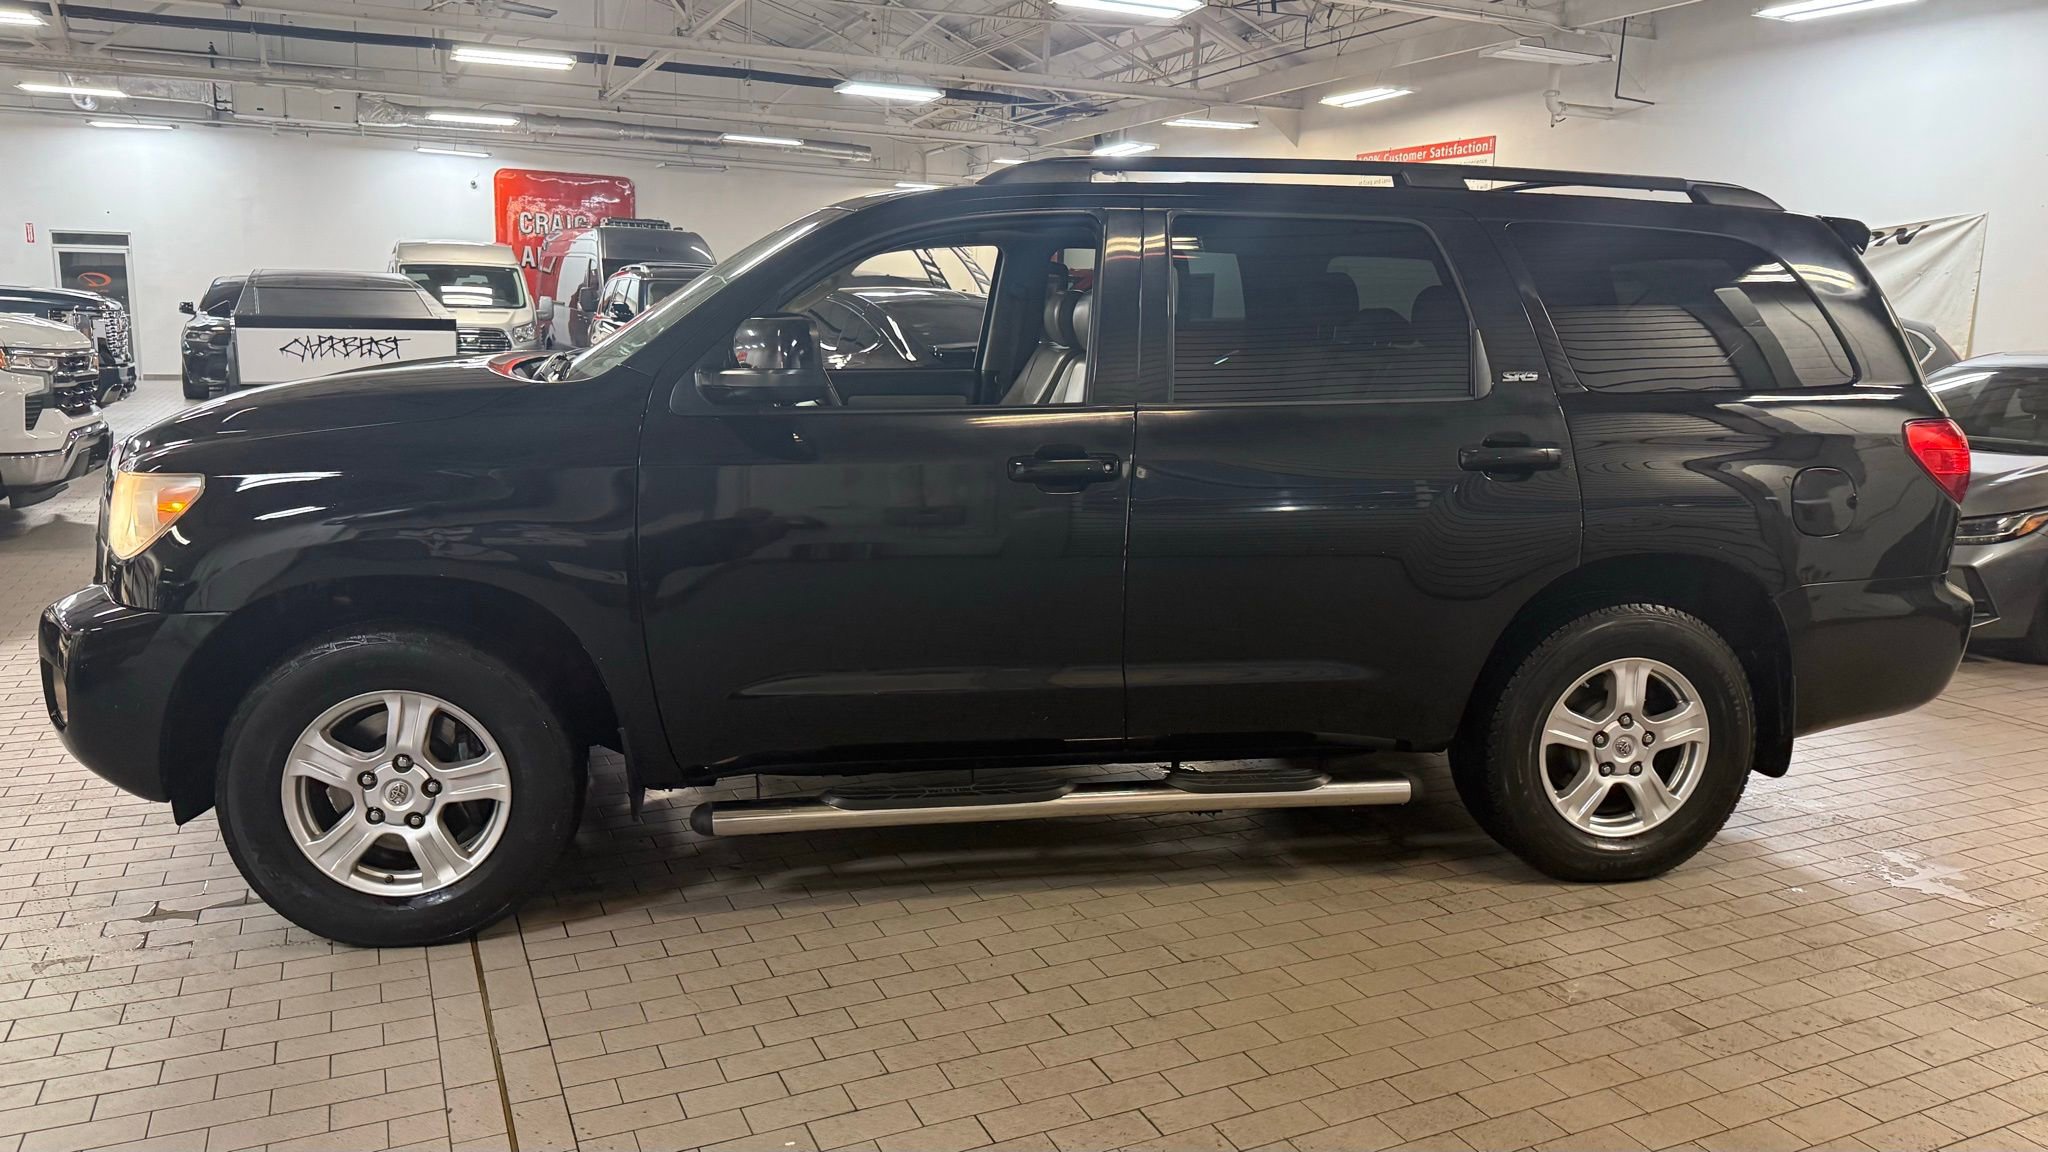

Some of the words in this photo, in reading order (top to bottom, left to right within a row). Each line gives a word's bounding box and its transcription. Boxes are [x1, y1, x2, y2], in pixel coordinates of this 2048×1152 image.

[1383, 150, 1427, 162] Customer
[1429, 138, 1493, 159] Satisfaction!
[1502, 371, 1539, 382] SR5
